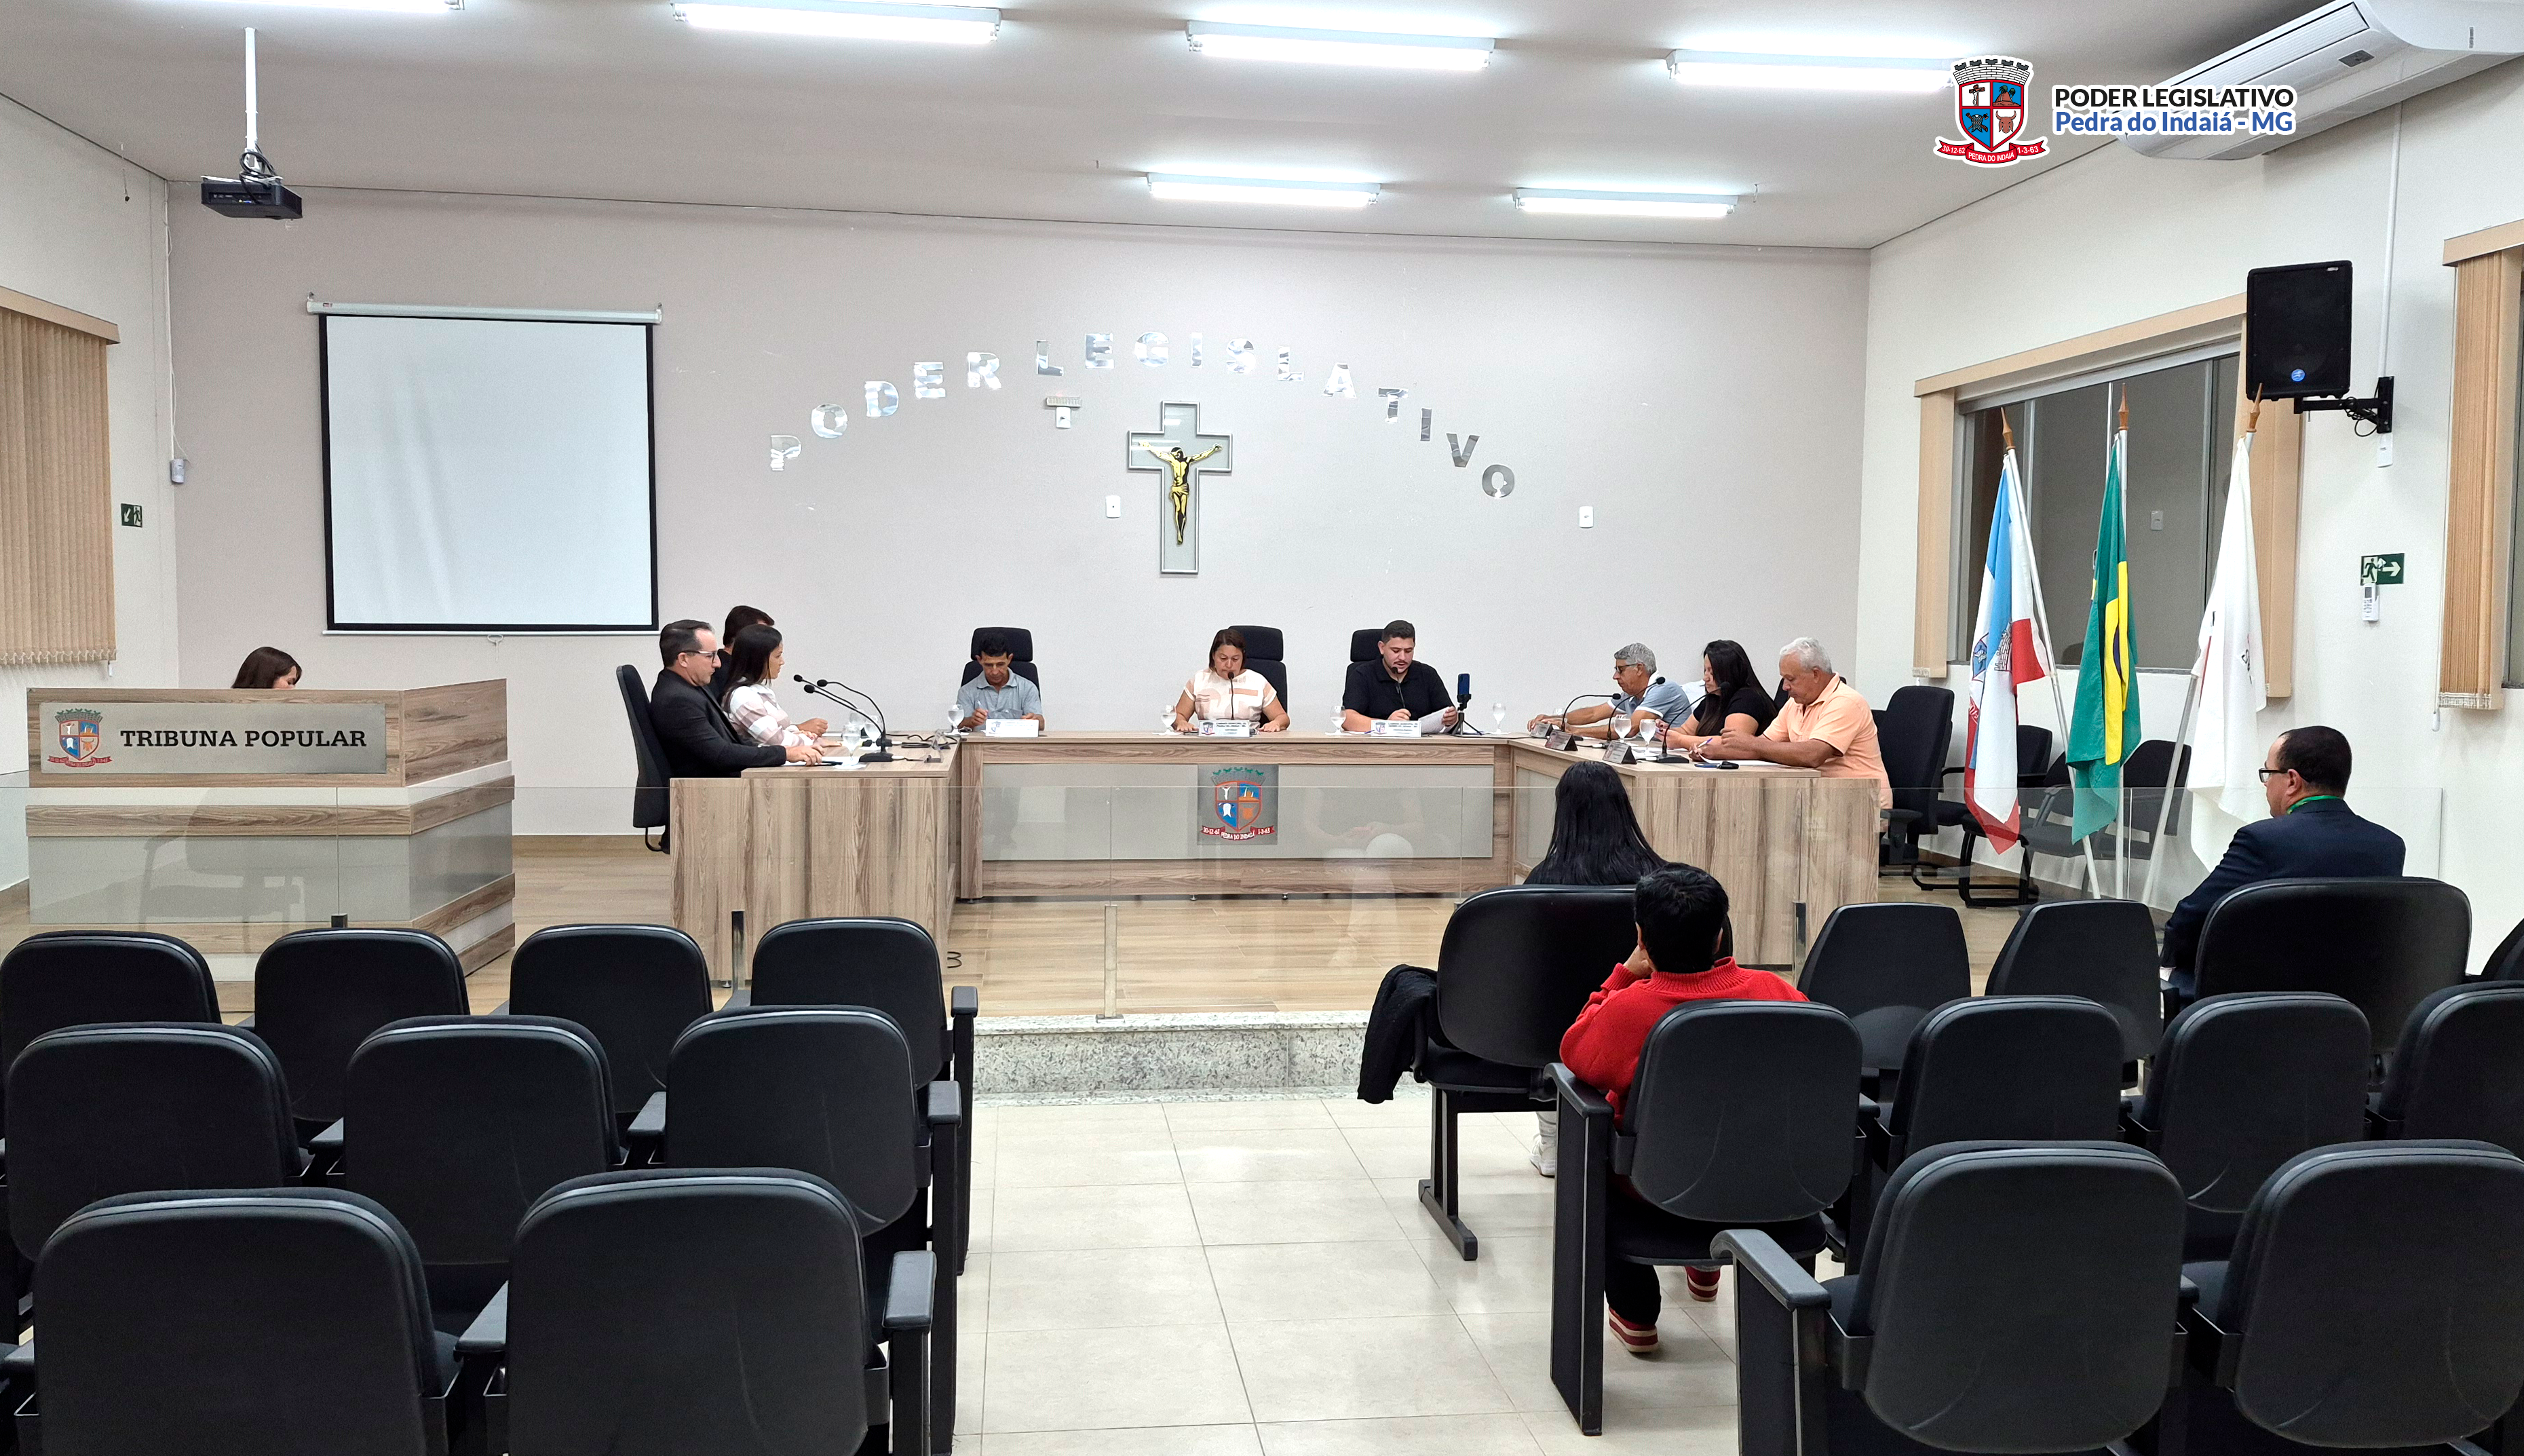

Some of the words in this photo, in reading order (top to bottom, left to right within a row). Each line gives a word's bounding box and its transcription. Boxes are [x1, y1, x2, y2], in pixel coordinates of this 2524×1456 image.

[770, 351, 1002, 471] PODER
[1036, 331, 1516, 499] LEGISLATIVO
[120, 730, 237, 747] TRIBUNA
[244, 730, 367, 747] POPULAR
